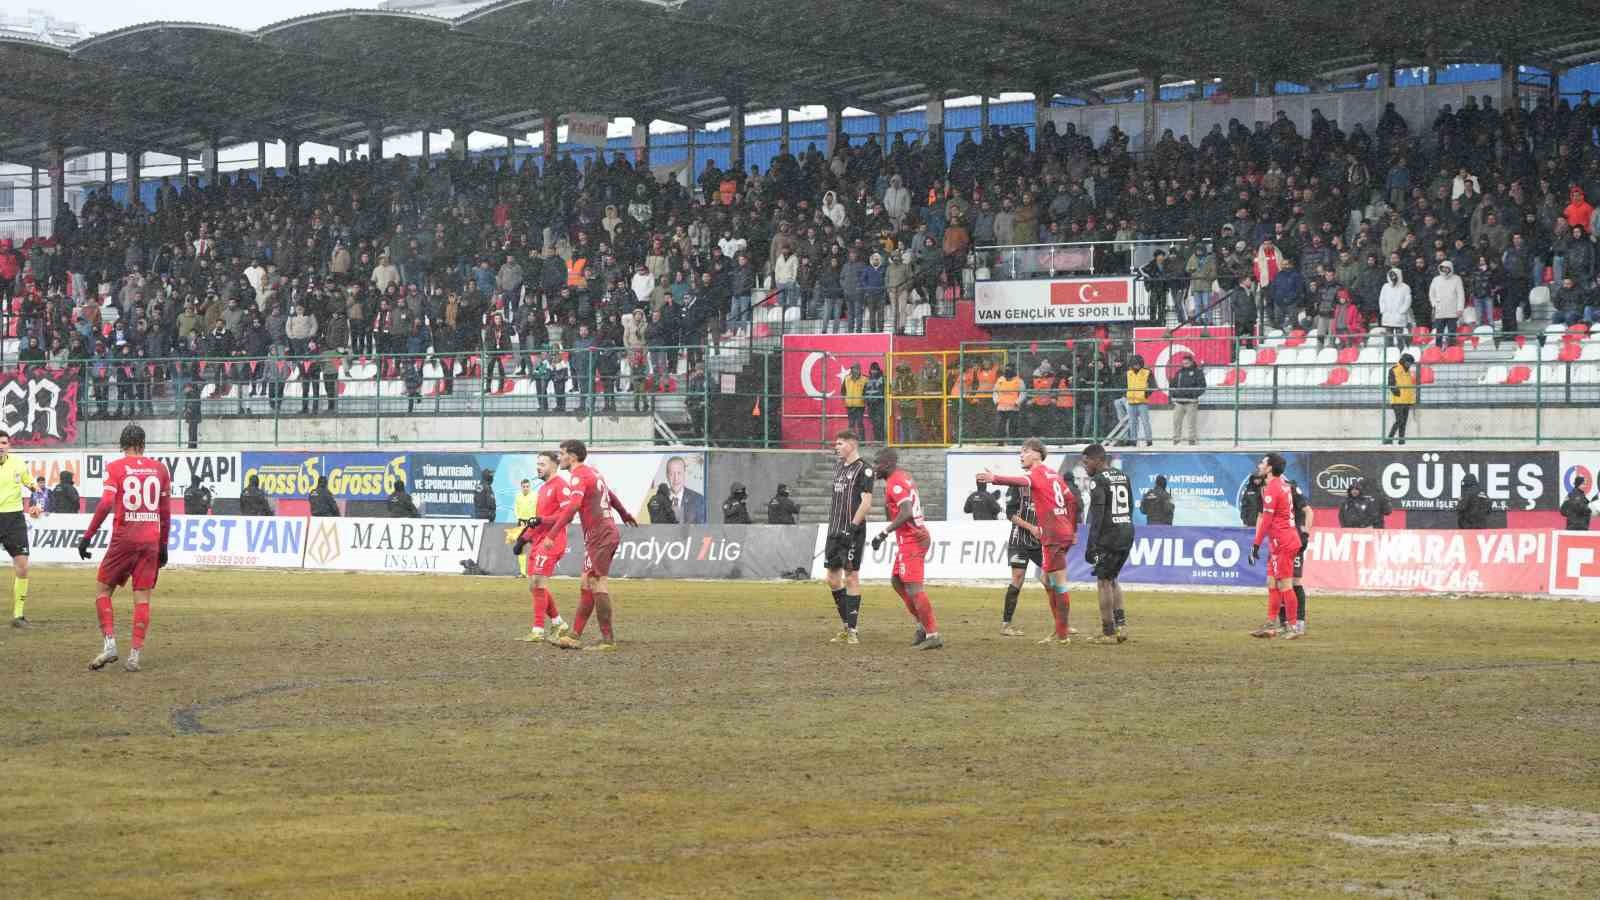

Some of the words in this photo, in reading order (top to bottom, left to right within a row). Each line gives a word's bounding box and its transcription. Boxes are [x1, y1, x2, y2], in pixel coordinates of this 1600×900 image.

[978, 309, 1001, 320] VAN
[1004, 306, 1056, 320] GENÇLİK
[1060, 307, 1074, 318] VE
[1078, 306, 1110, 318] SPOR
[1113, 304, 1125, 317] İL
[187, 456, 236, 482] YAPI
[1382, 453, 1544, 510] GÜNEŞ
[122, 475, 161, 511] 80
[1053, 480, 1065, 507] 8
[1110, 485, 1130, 515] 19
[1401, 499, 1434, 510] YATIRIM
[169, 518, 237, 553] BEST
[245, 520, 303, 554] VAN
[349, 523, 479, 551] MABEYN
[1477, 533, 1546, 563] YAPI
[847, 548, 855, 561] 6
[1129, 538, 1241, 568] WILCO
[1192, 570, 1218, 578] SINCE
